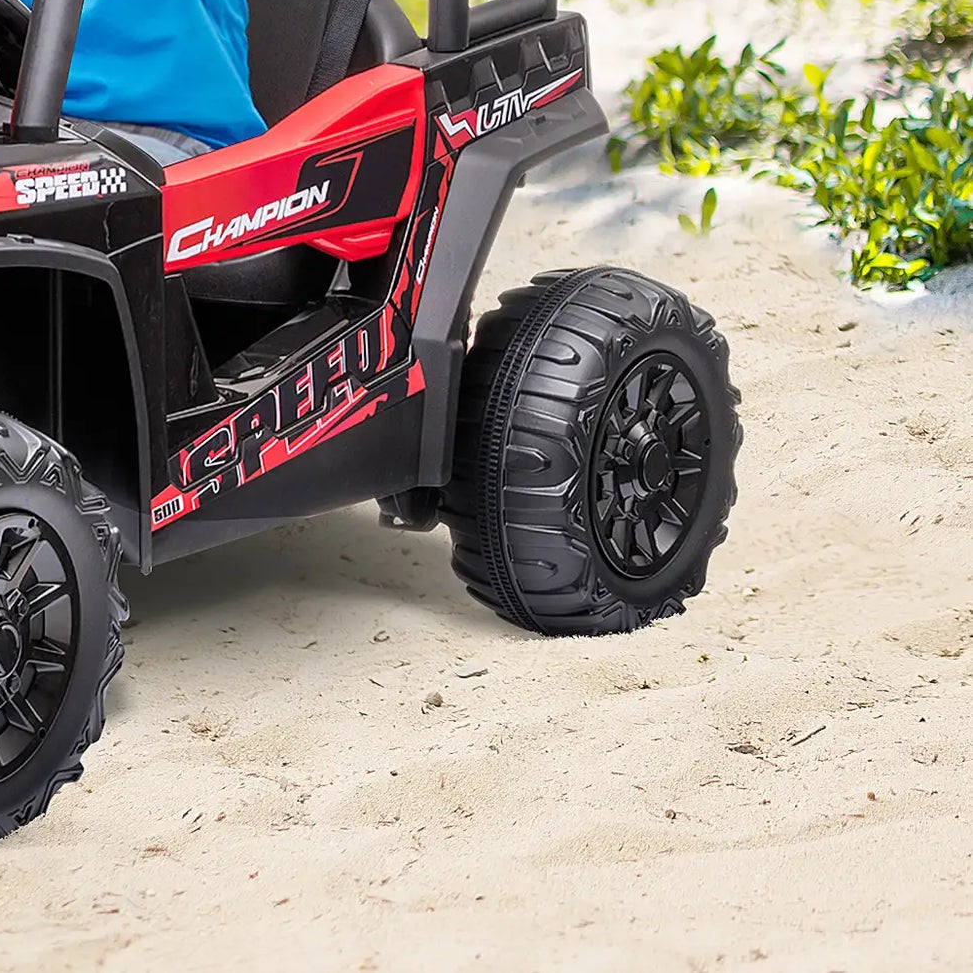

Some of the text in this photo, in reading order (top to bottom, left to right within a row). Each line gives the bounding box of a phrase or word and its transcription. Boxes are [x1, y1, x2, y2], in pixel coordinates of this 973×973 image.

[15, 170, 100, 204] SPEED
[167, 180, 330, 262] CHAMPION
[181, 310, 388, 510] SPEED
